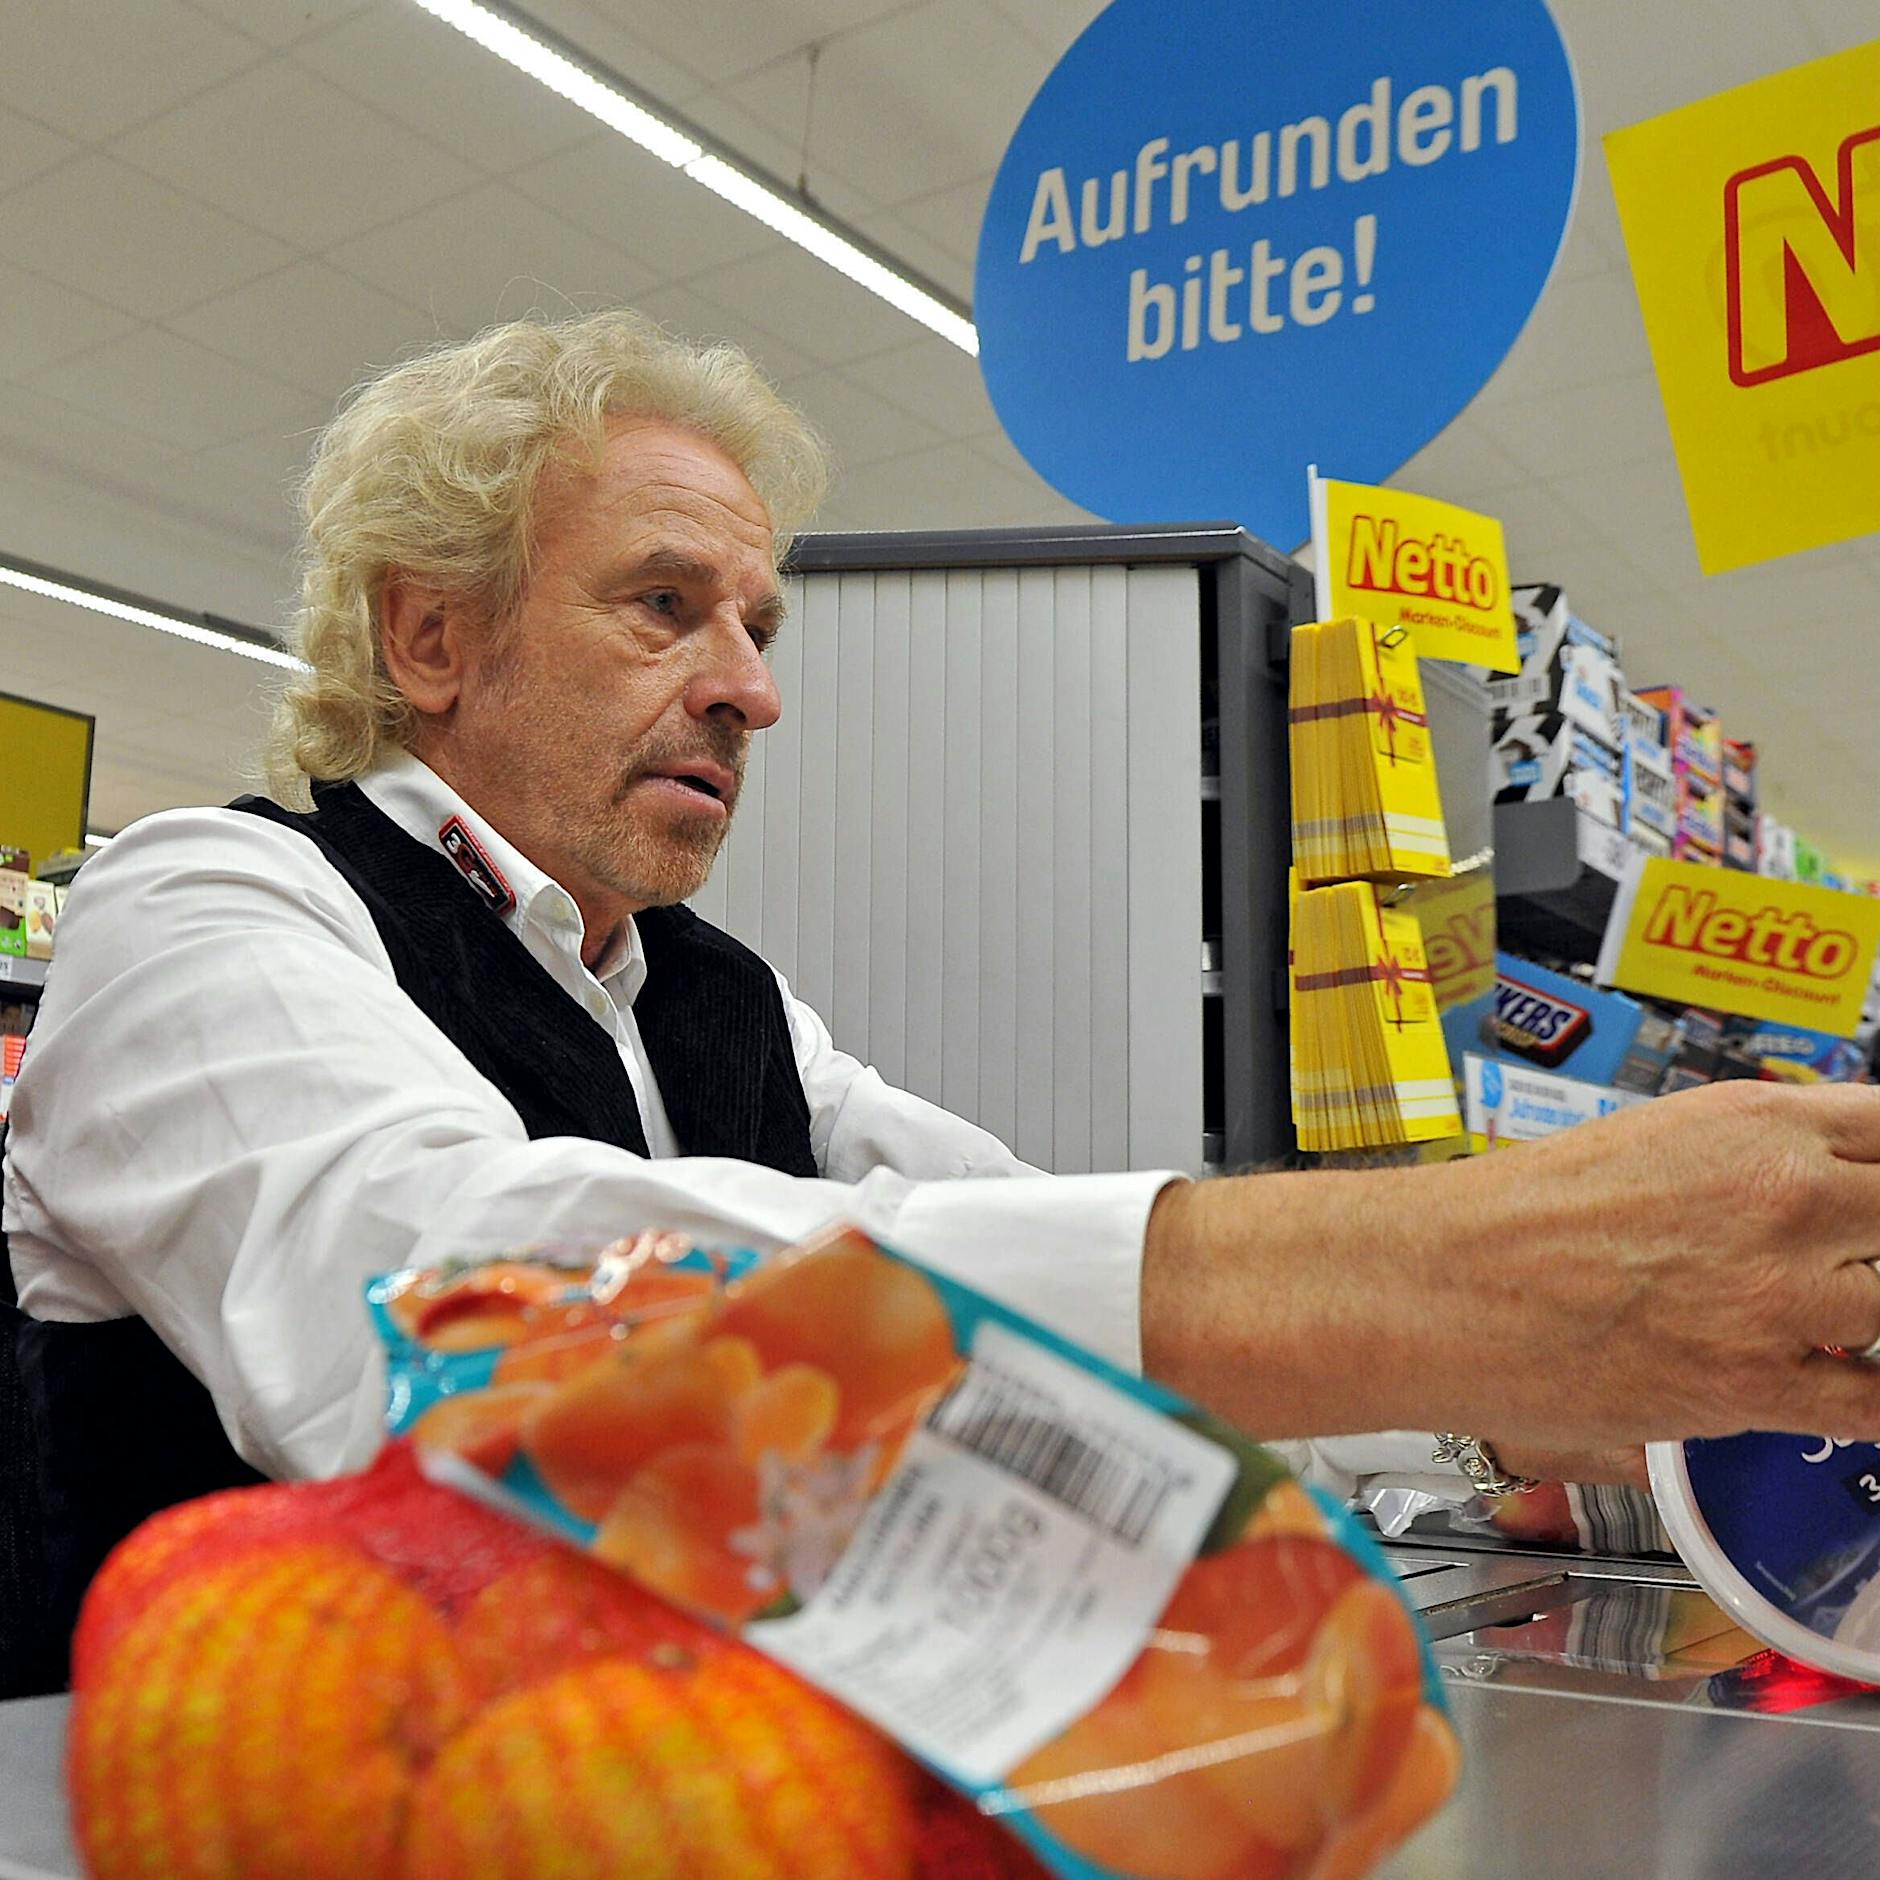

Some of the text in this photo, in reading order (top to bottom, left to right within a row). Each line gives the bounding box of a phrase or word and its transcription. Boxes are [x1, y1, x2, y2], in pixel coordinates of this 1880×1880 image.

[1019, 67, 1518, 264] Aufrunden
[1127, 214, 1377, 362] bitte!
[1347, 514, 1498, 611] Netto
[1644, 883, 1858, 980] Netto
